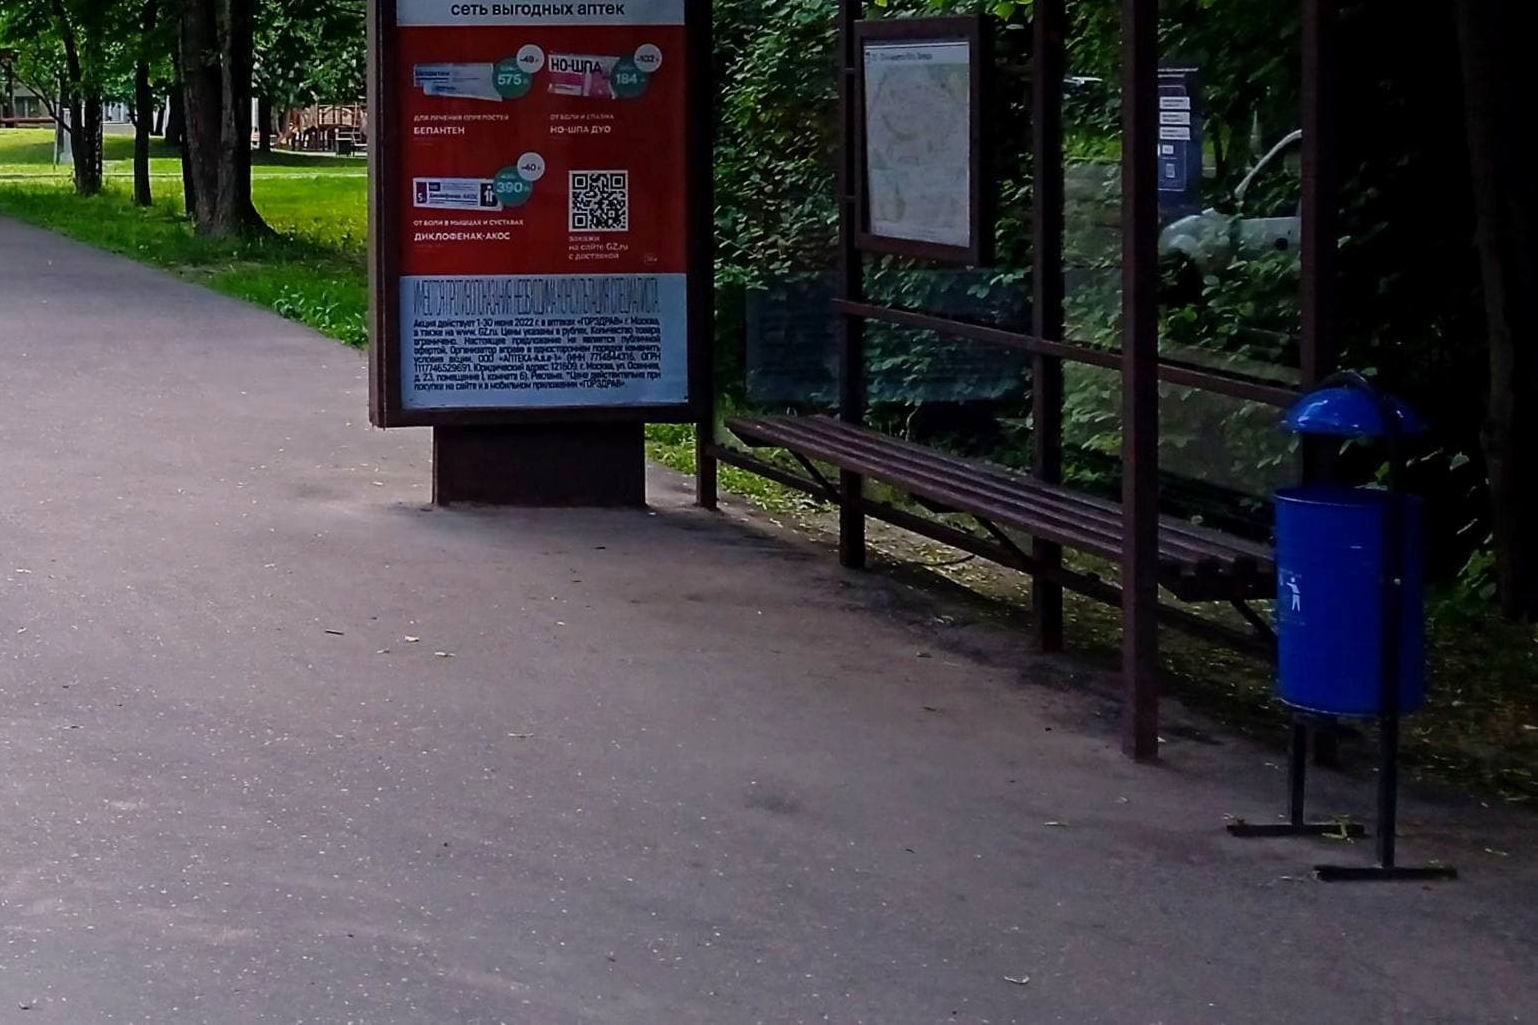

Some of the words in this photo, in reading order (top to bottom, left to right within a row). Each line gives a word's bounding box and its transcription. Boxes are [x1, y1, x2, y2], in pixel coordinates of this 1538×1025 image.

[451, 4, 488, 16] сеть
[492, 3, 573, 18] выгодных
[578, 2, 625, 17] аптек
[550, 56, 603, 73] НО-ШПА
[497, 73, 523, 86] 575
[615, 72, 639, 85] 184
[413, 126, 466, 135] БЕПАНТЕН
[549, 125, 590, 134] НО-ШПА
[590, 125, 612, 134] ДУО
[496, 181, 524, 193] 390
[414, 231, 511, 242] ДИКЛОФЕНАК-АКОС
[514, 319, 535, 327] 2022
